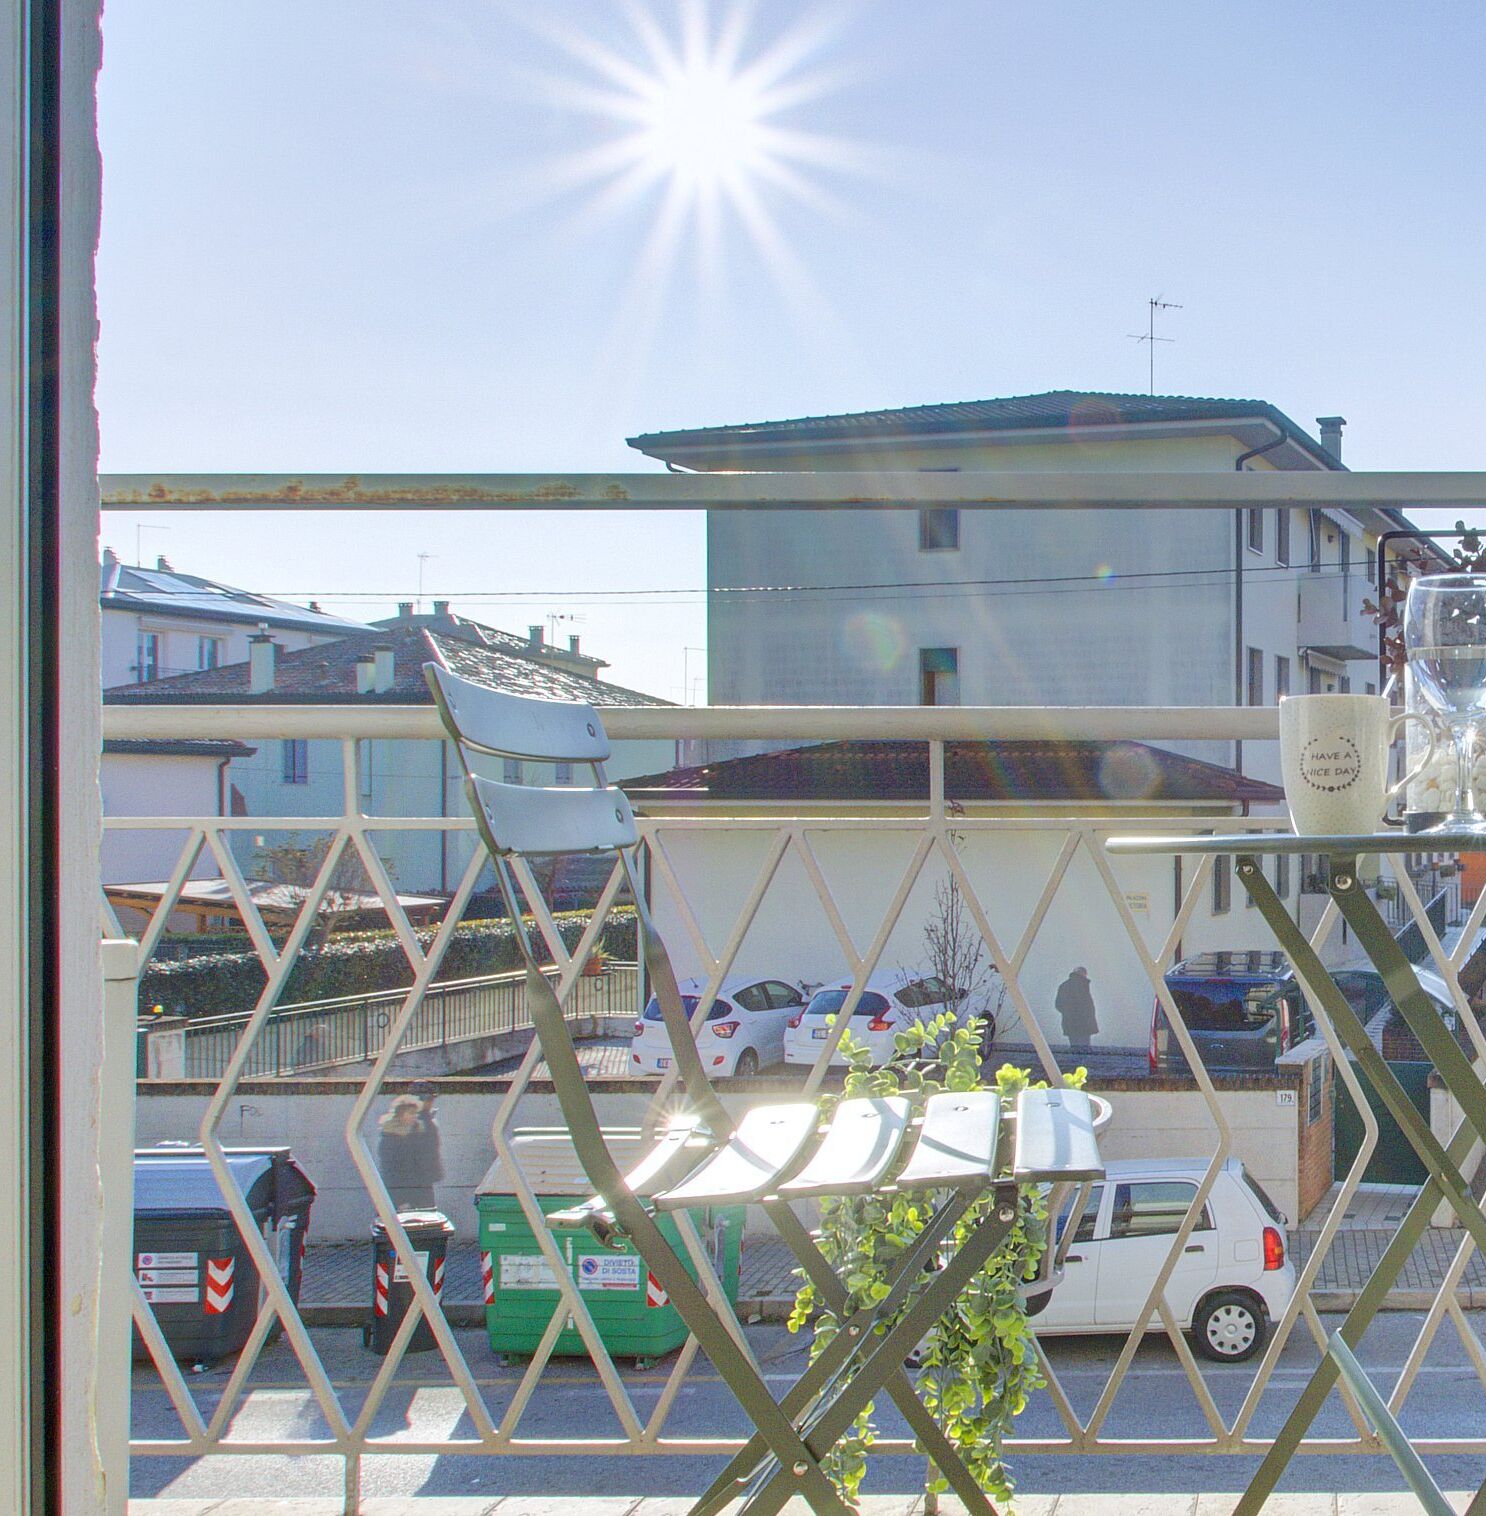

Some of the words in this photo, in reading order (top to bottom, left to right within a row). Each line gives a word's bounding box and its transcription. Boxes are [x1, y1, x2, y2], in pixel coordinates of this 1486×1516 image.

[1311, 752, 1340, 760] HAVE
[1344, 752, 1352, 760] A
[1306, 768, 1330, 776] NICE
[1335, 767, 1356, 776] DAY
[604, 1259, 634, 1267] DIVIETO
